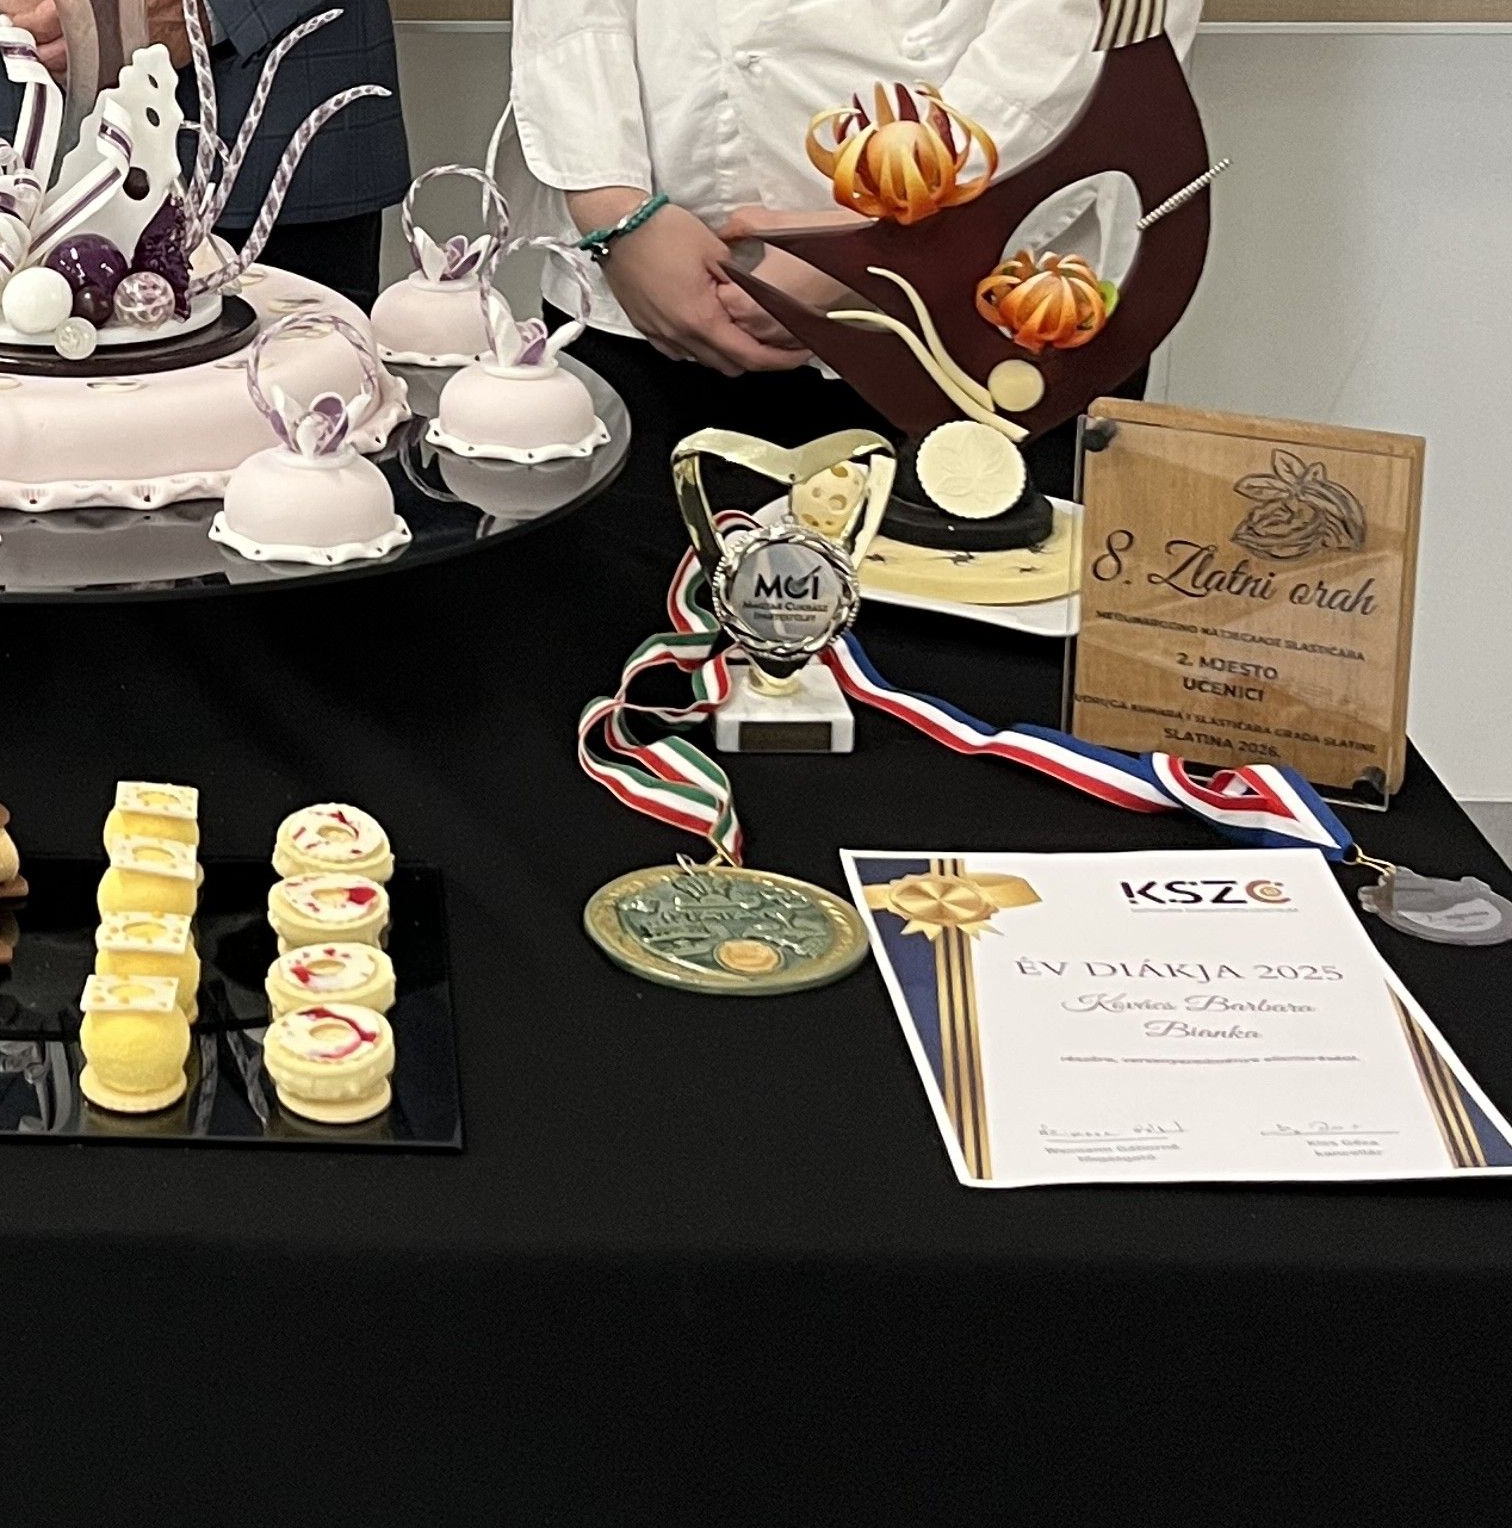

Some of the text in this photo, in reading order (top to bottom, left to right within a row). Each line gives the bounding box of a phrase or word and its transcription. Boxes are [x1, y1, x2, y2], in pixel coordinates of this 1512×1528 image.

[1092, 529, 1380, 615] 8. Zlatni orah
[1164, 727, 1234, 749] SLATINA
[1120, 880, 1291, 904] KSZC
[1015, 956, 1344, 983] ÉV DIÁKJA 2025
[1184, 995, 1316, 1013] Barbara
[1143, 1019, 1263, 1040] Bianka
